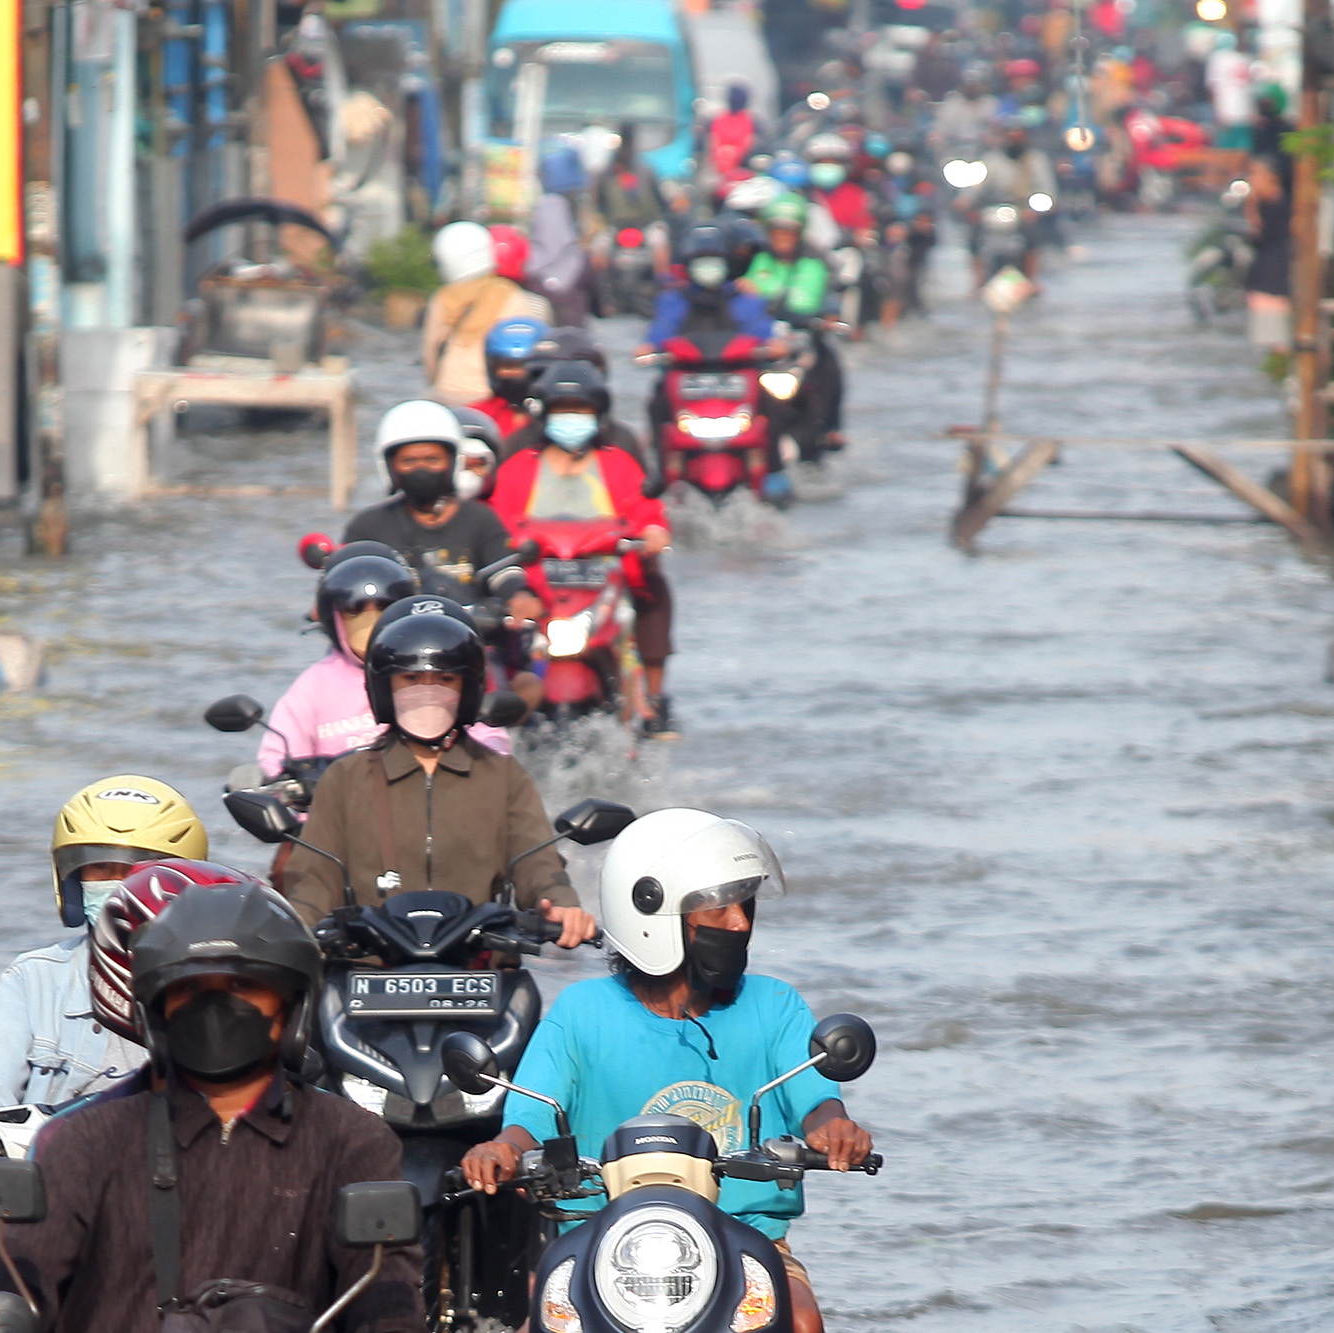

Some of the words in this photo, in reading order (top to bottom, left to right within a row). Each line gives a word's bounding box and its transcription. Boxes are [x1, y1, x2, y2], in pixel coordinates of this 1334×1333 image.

[105, 790, 153, 802] INK
[356, 978, 370, 994] N
[385, 978, 438, 994] 6503
[451, 978, 492, 994] ECS
